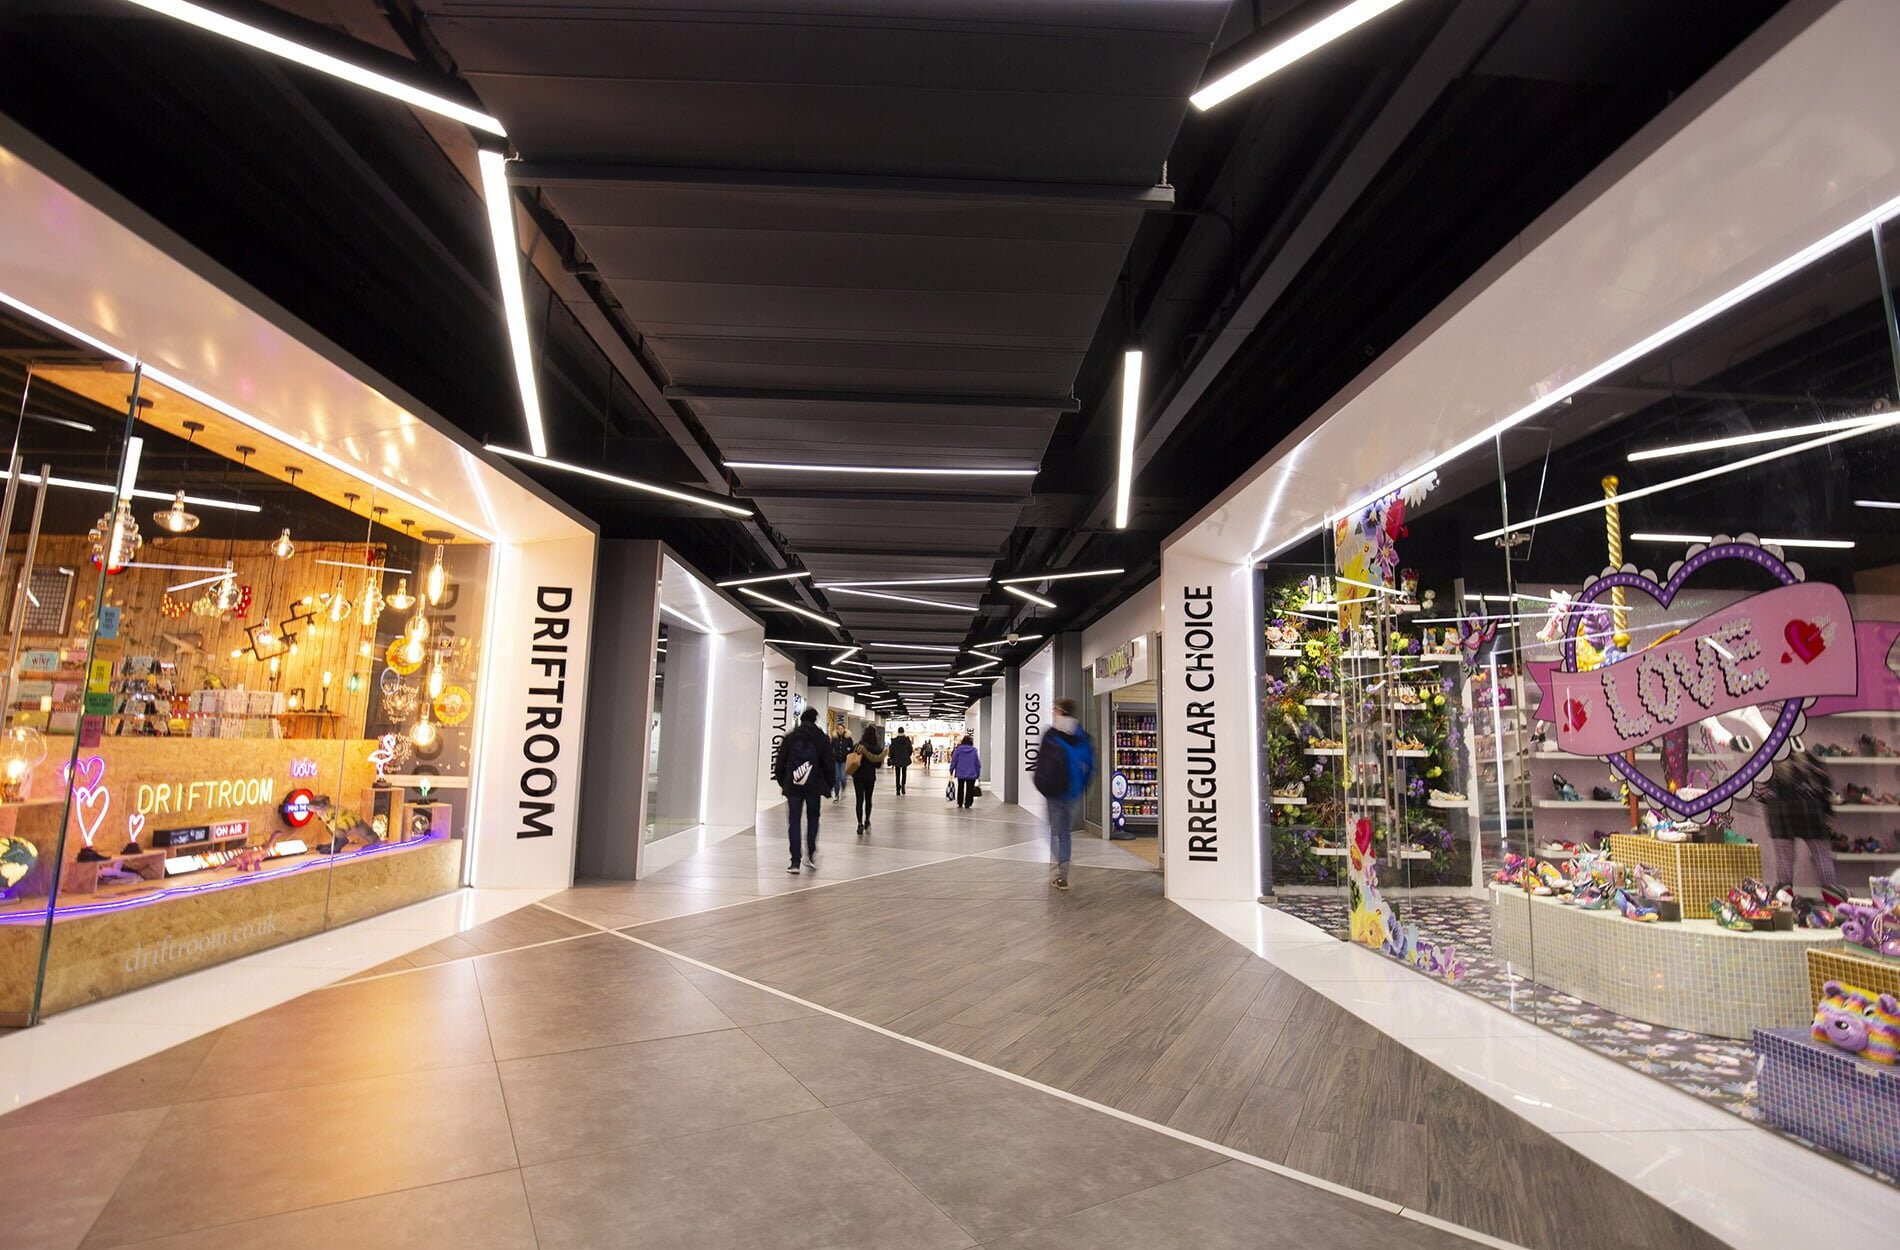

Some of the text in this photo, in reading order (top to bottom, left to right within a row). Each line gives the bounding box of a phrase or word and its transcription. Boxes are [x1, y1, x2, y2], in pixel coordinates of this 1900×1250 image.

[772, 680, 788, 732] PRETTY
[1602, 617, 1769, 739] LOVE
[516, 586, 573, 840] DRIFTROOM
[1025, 693, 1040, 771] NOT DOGS
[1184, 586, 1218, 862] IRREGULAR CHOICE
[137, 777, 274, 815] DRIFTROOM
[793, 760, 811, 781] NIKE
[215, 825, 229, 837] ON
[229, 823, 243, 835] AIR
[122, 910, 278, 973] driftroom.co.uk
